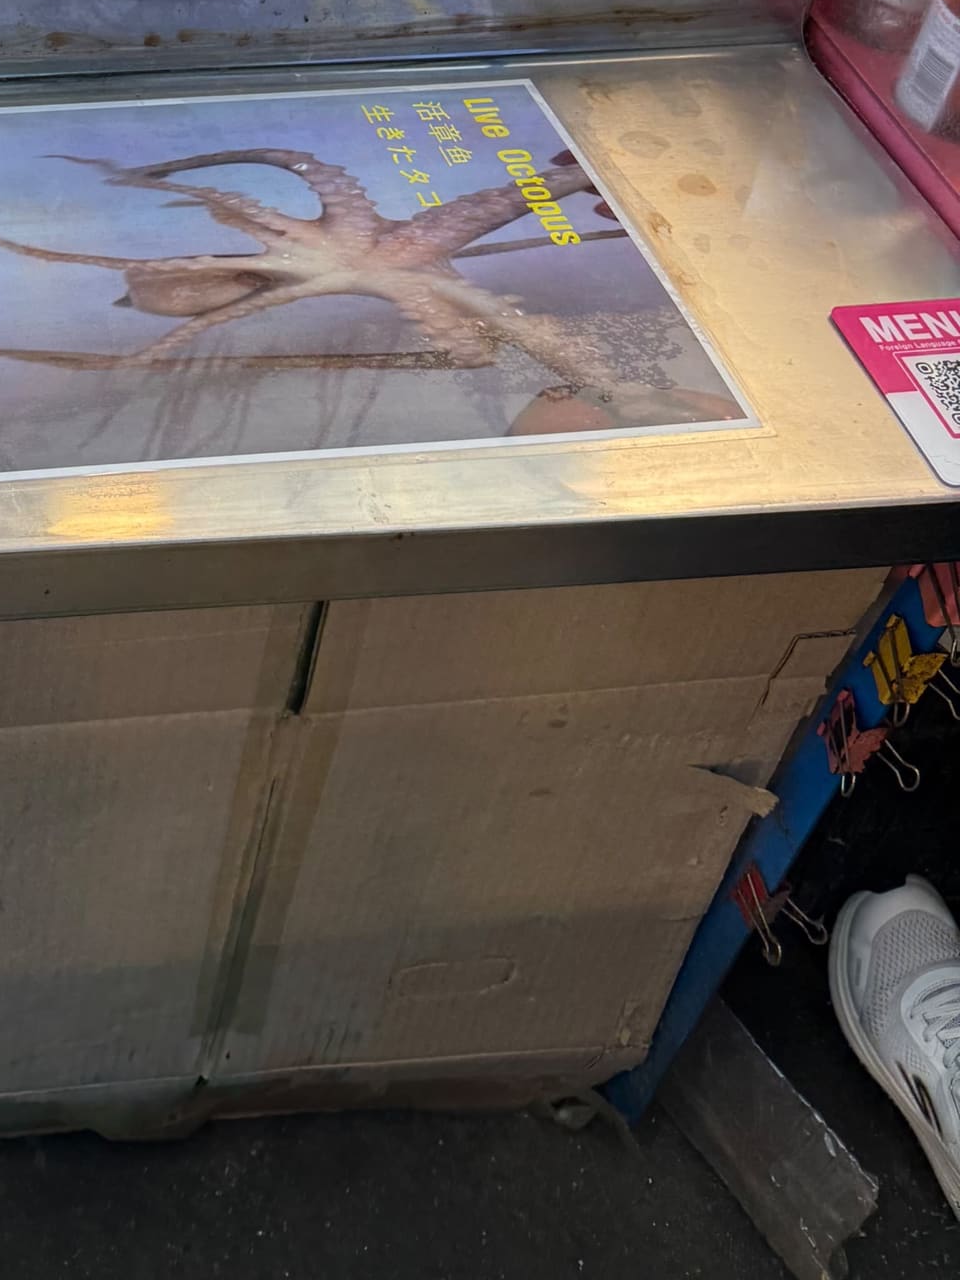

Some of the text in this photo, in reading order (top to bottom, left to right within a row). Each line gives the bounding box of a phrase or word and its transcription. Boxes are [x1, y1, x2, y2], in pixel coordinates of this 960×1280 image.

[360, 104, 443, 209] 生きたタコ
[412, 100, 473, 168] 活章鱼
[496, 148, 582, 248] Octopus
